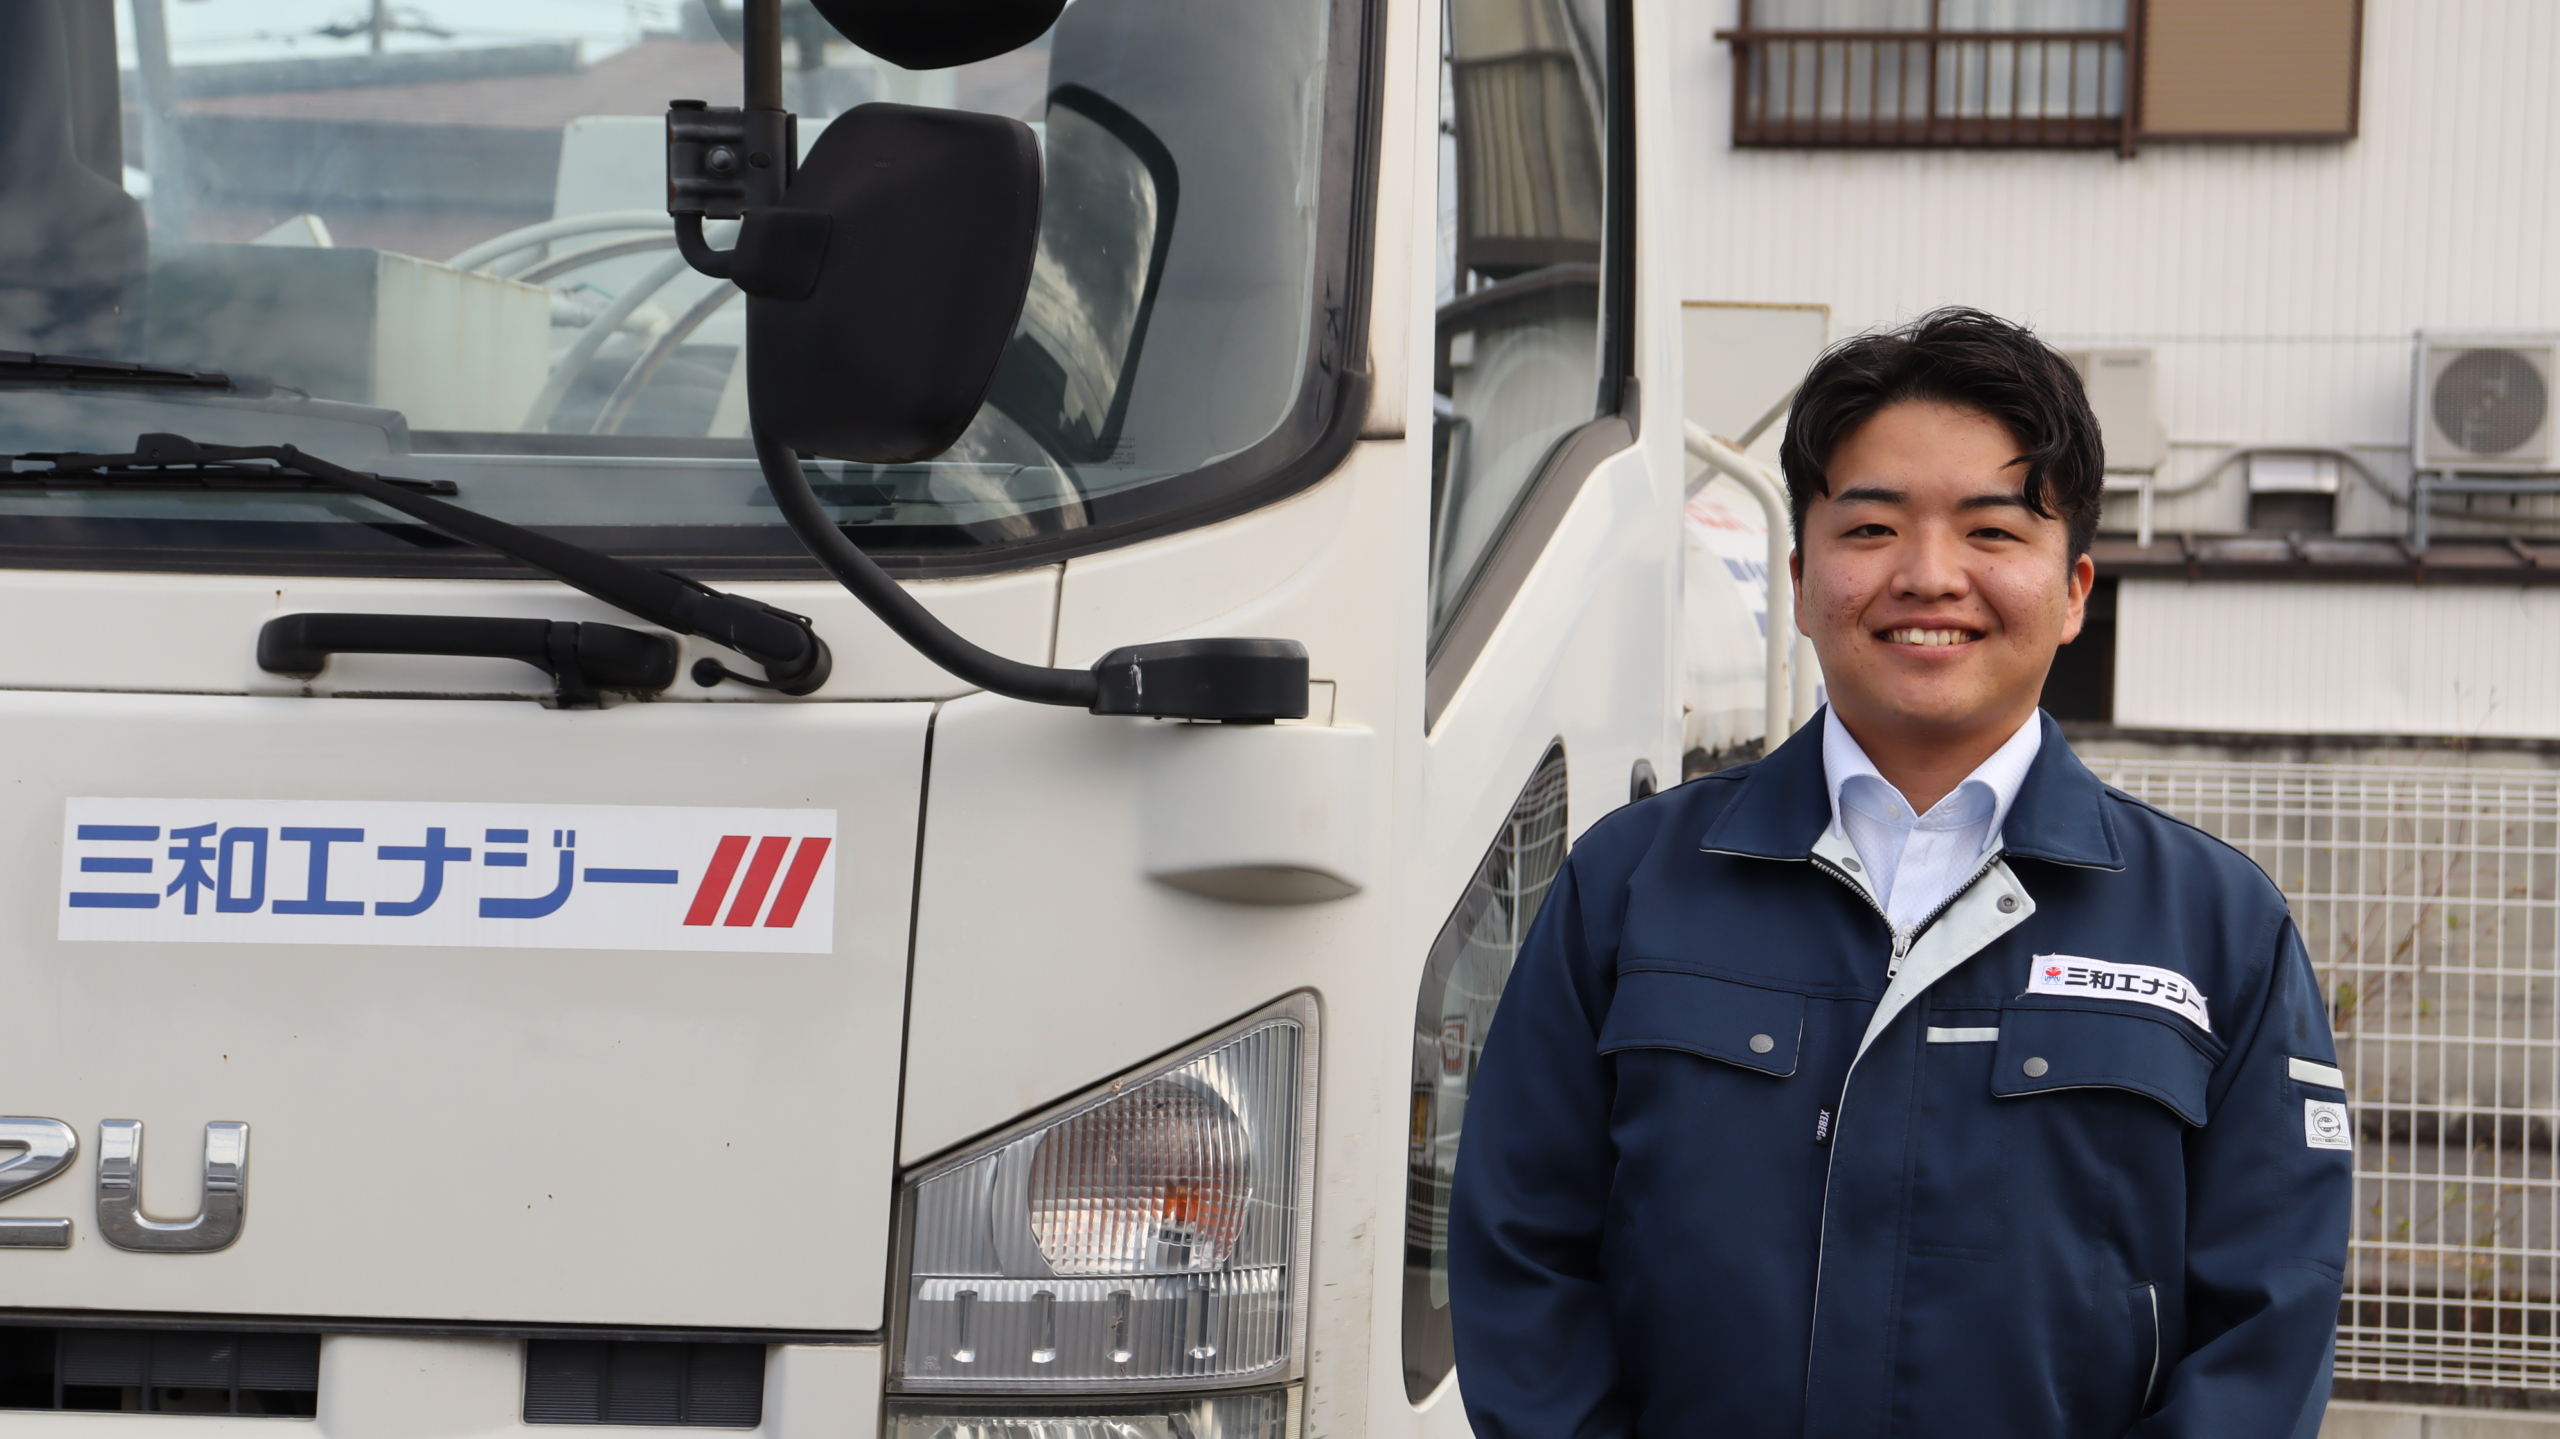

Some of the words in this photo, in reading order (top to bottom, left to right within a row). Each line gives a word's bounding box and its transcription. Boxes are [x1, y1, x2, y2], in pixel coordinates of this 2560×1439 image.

[69, 822, 679, 920] 三和エナジー
[2065, 966, 2201, 1011] 三和エナジー
[1816, 1108, 1831, 1138] XEBEC
